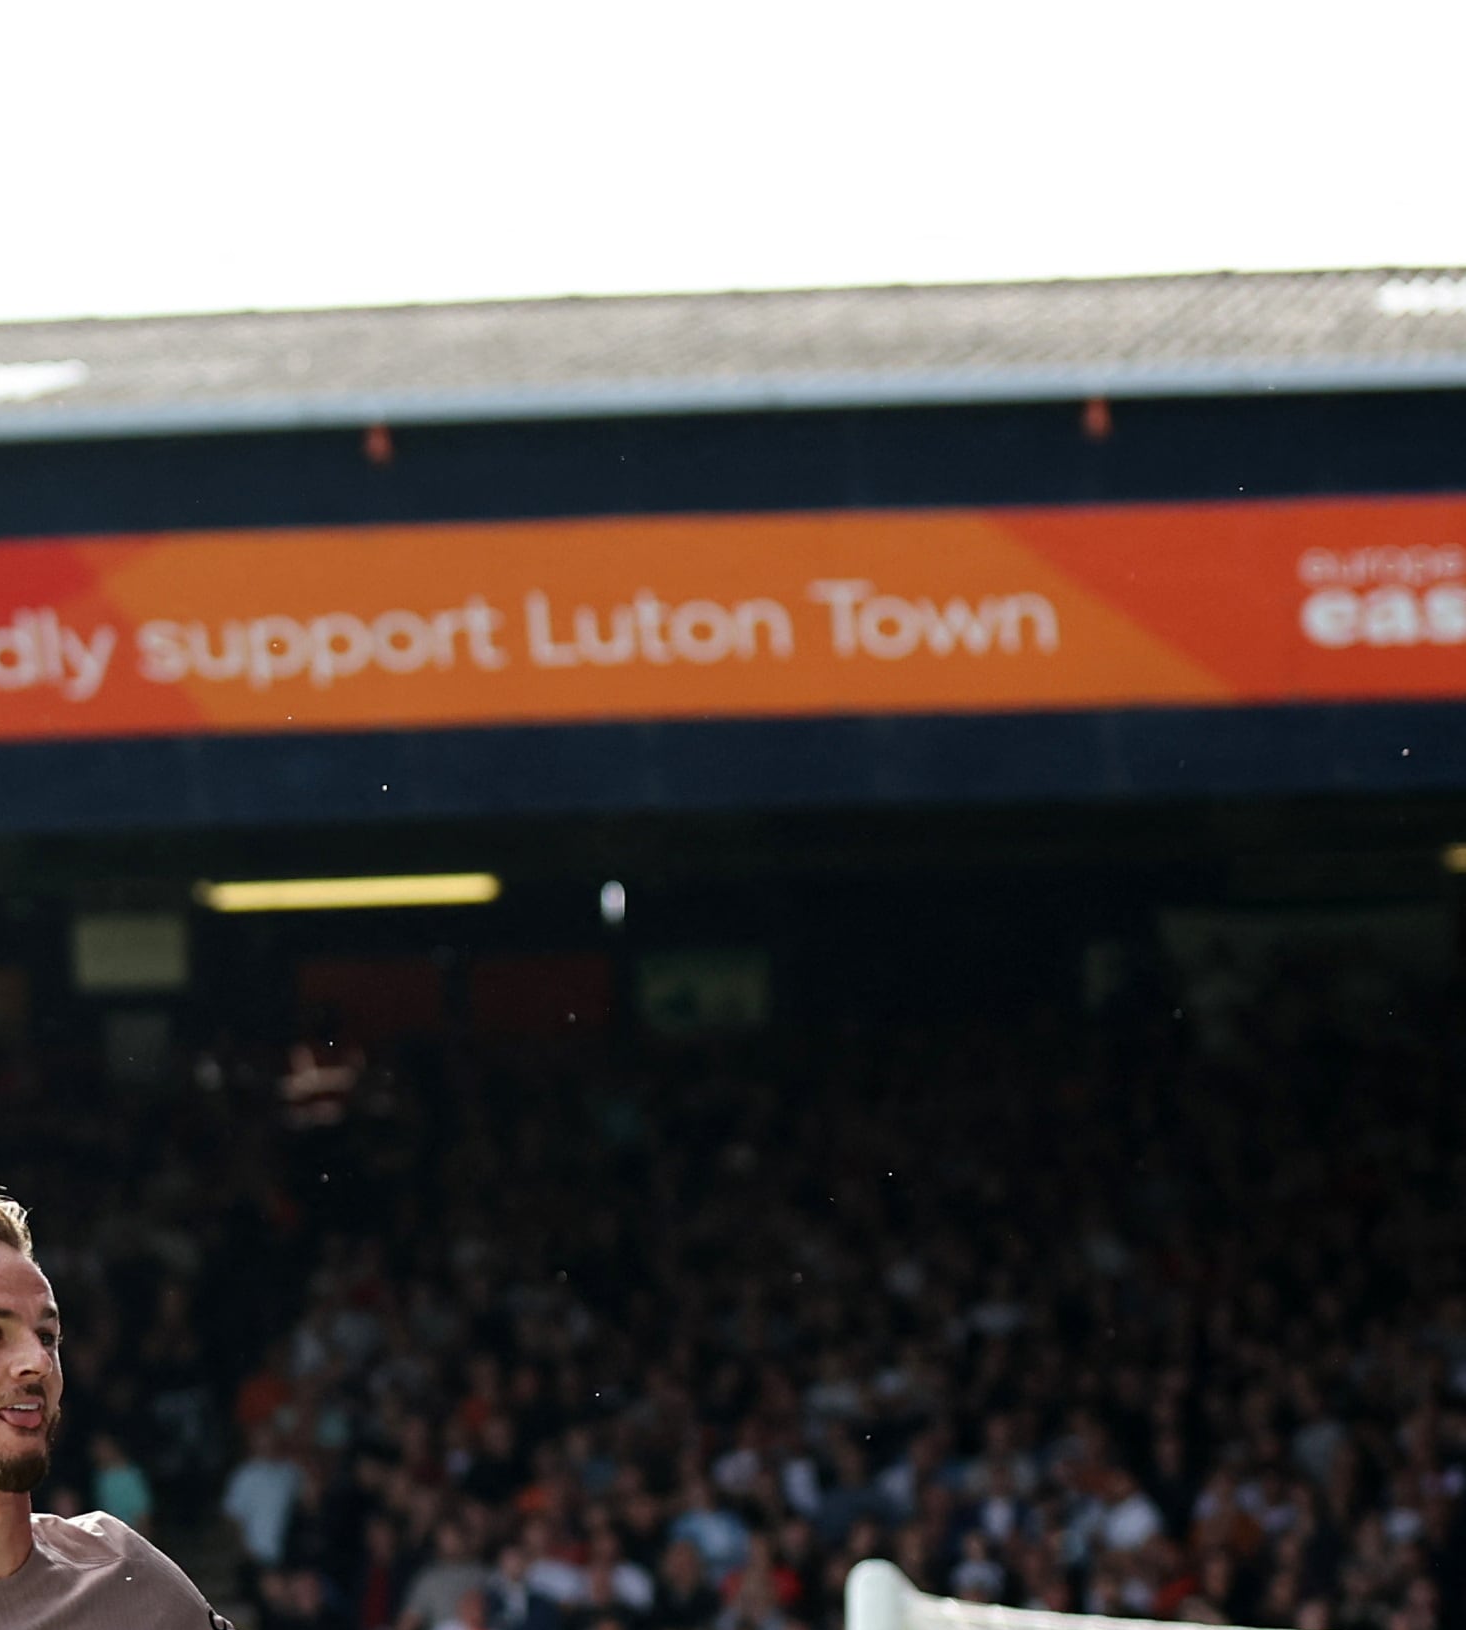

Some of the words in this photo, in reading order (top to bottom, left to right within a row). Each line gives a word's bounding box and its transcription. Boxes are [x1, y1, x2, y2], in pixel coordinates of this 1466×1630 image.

[136, 592, 508, 690] support
[524, 586, 795, 668] Luton
[807, 576, 1062, 660] Town
